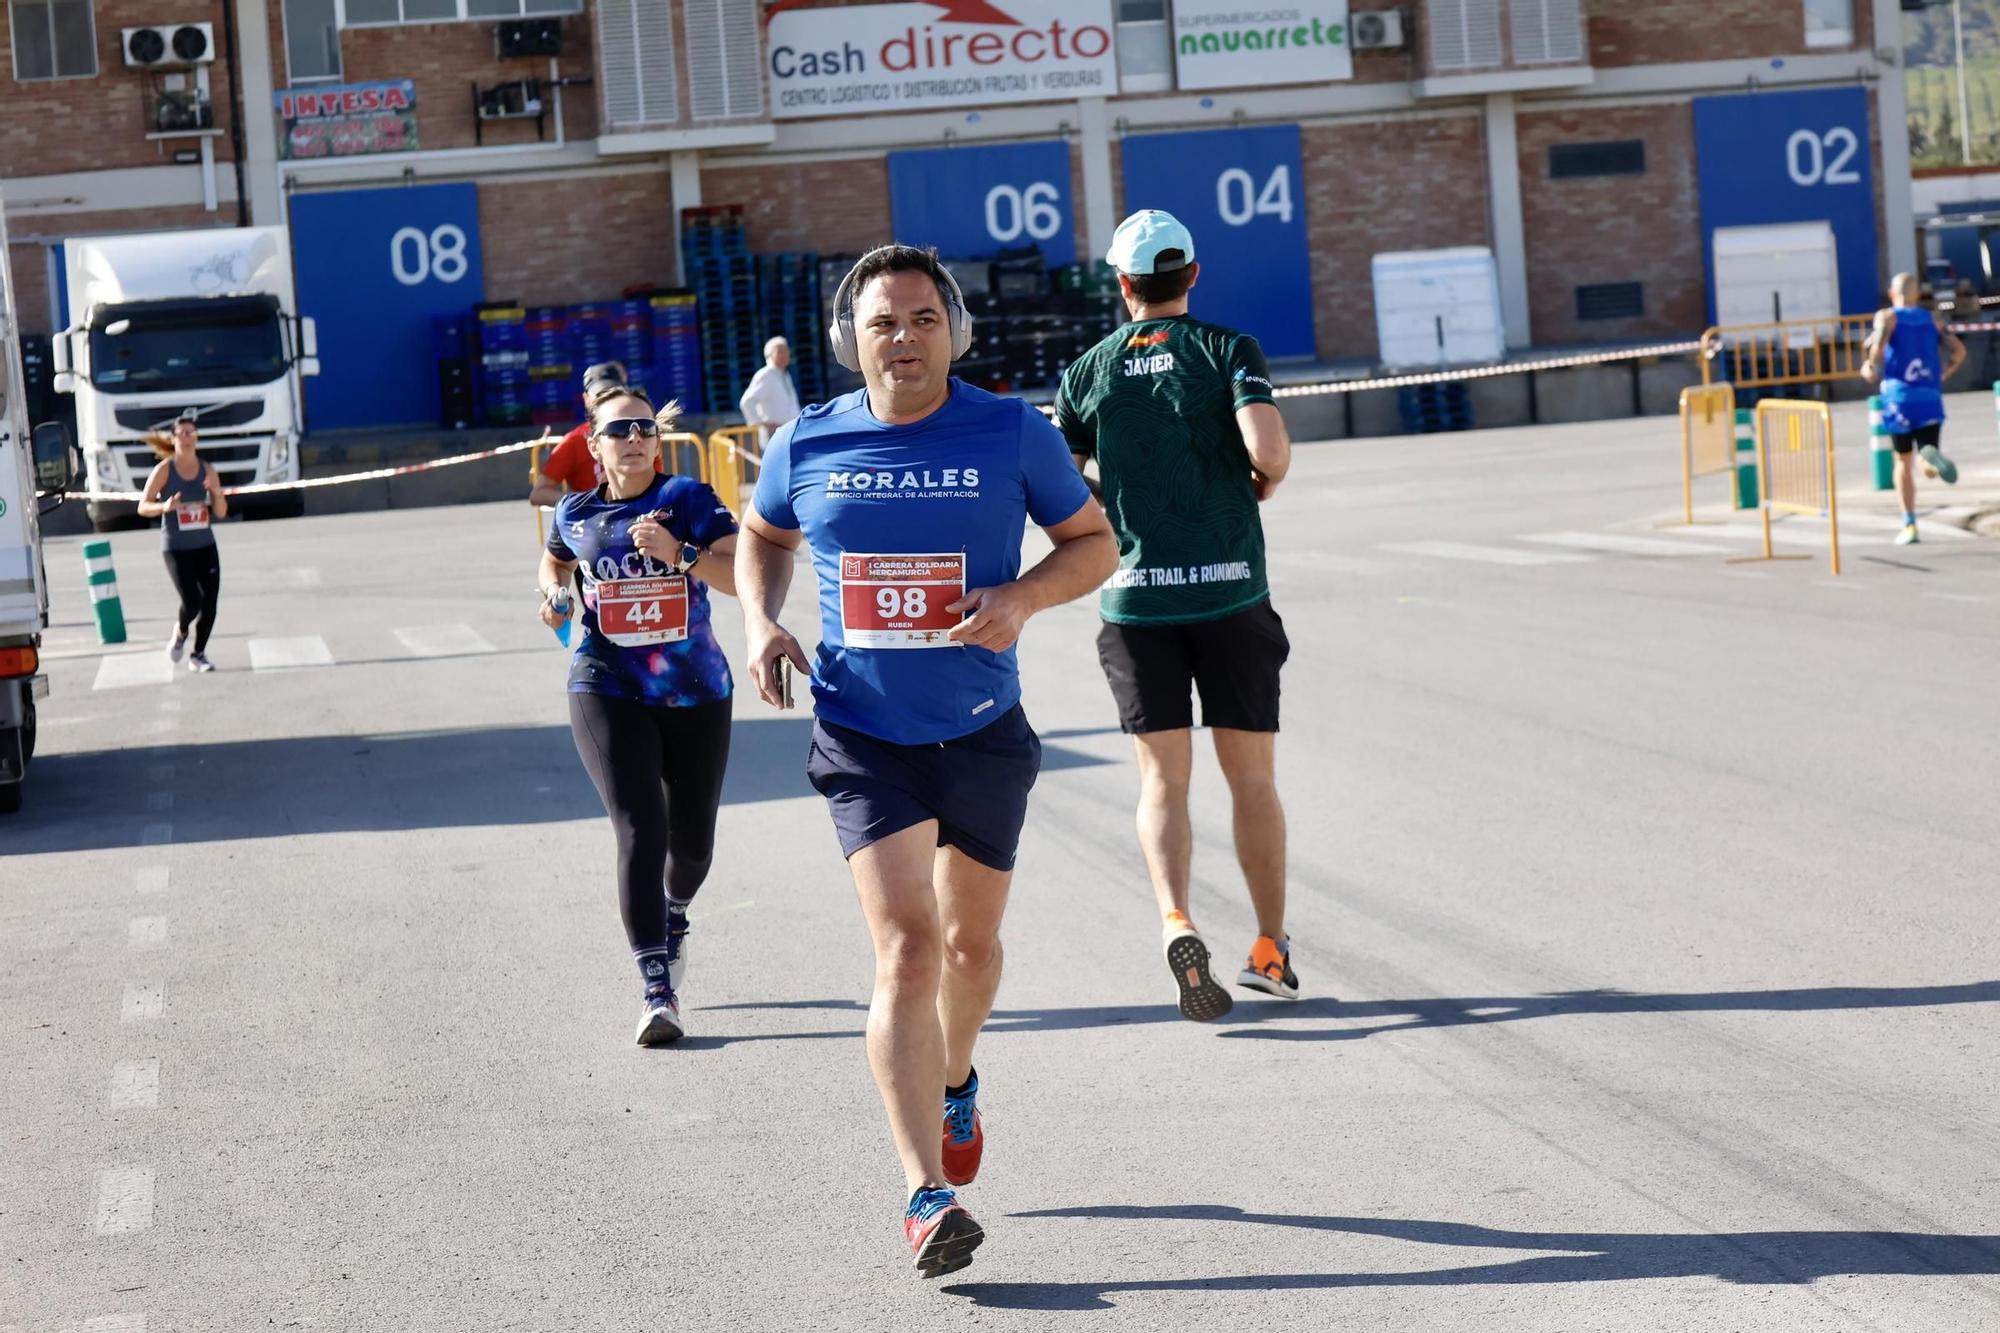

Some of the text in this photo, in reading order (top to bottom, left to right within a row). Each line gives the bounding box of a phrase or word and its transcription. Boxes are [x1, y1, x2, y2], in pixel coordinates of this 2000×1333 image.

[1179, 10, 1299, 26] SUPERMERCADOS
[771, 18, 1109, 78] Cash directo
[283, 87, 407, 118] INTESA
[781, 87, 827, 106] CENTRO
[893, 83, 900, 99] Y
[985, 74, 1026, 92] FRUTAS
[1030, 74, 1037, 88] Y
[1044, 69, 1102, 88] VERDURAS
[1786, 126, 1861, 186] 02
[1217, 165, 1292, 226] 04
[985, 182, 1061, 242] 06
[391, 223, 468, 285] 08
[1124, 353, 1173, 376] JAVIER
[826, 491, 861, 499] SERVICIO
[918, 490, 979, 498] ALIMENTACIÓN
[827, 468, 979, 490] MORALES
[915, 561, 960, 569] SOLIDARIA
[1149, 567, 1187, 587] TRAIL
[1189, 566, 1199, 584] &
[1201, 561, 1250, 583] RUNNING
[625, 600, 663, 624] 44
[876, 587, 927, 618] 98
